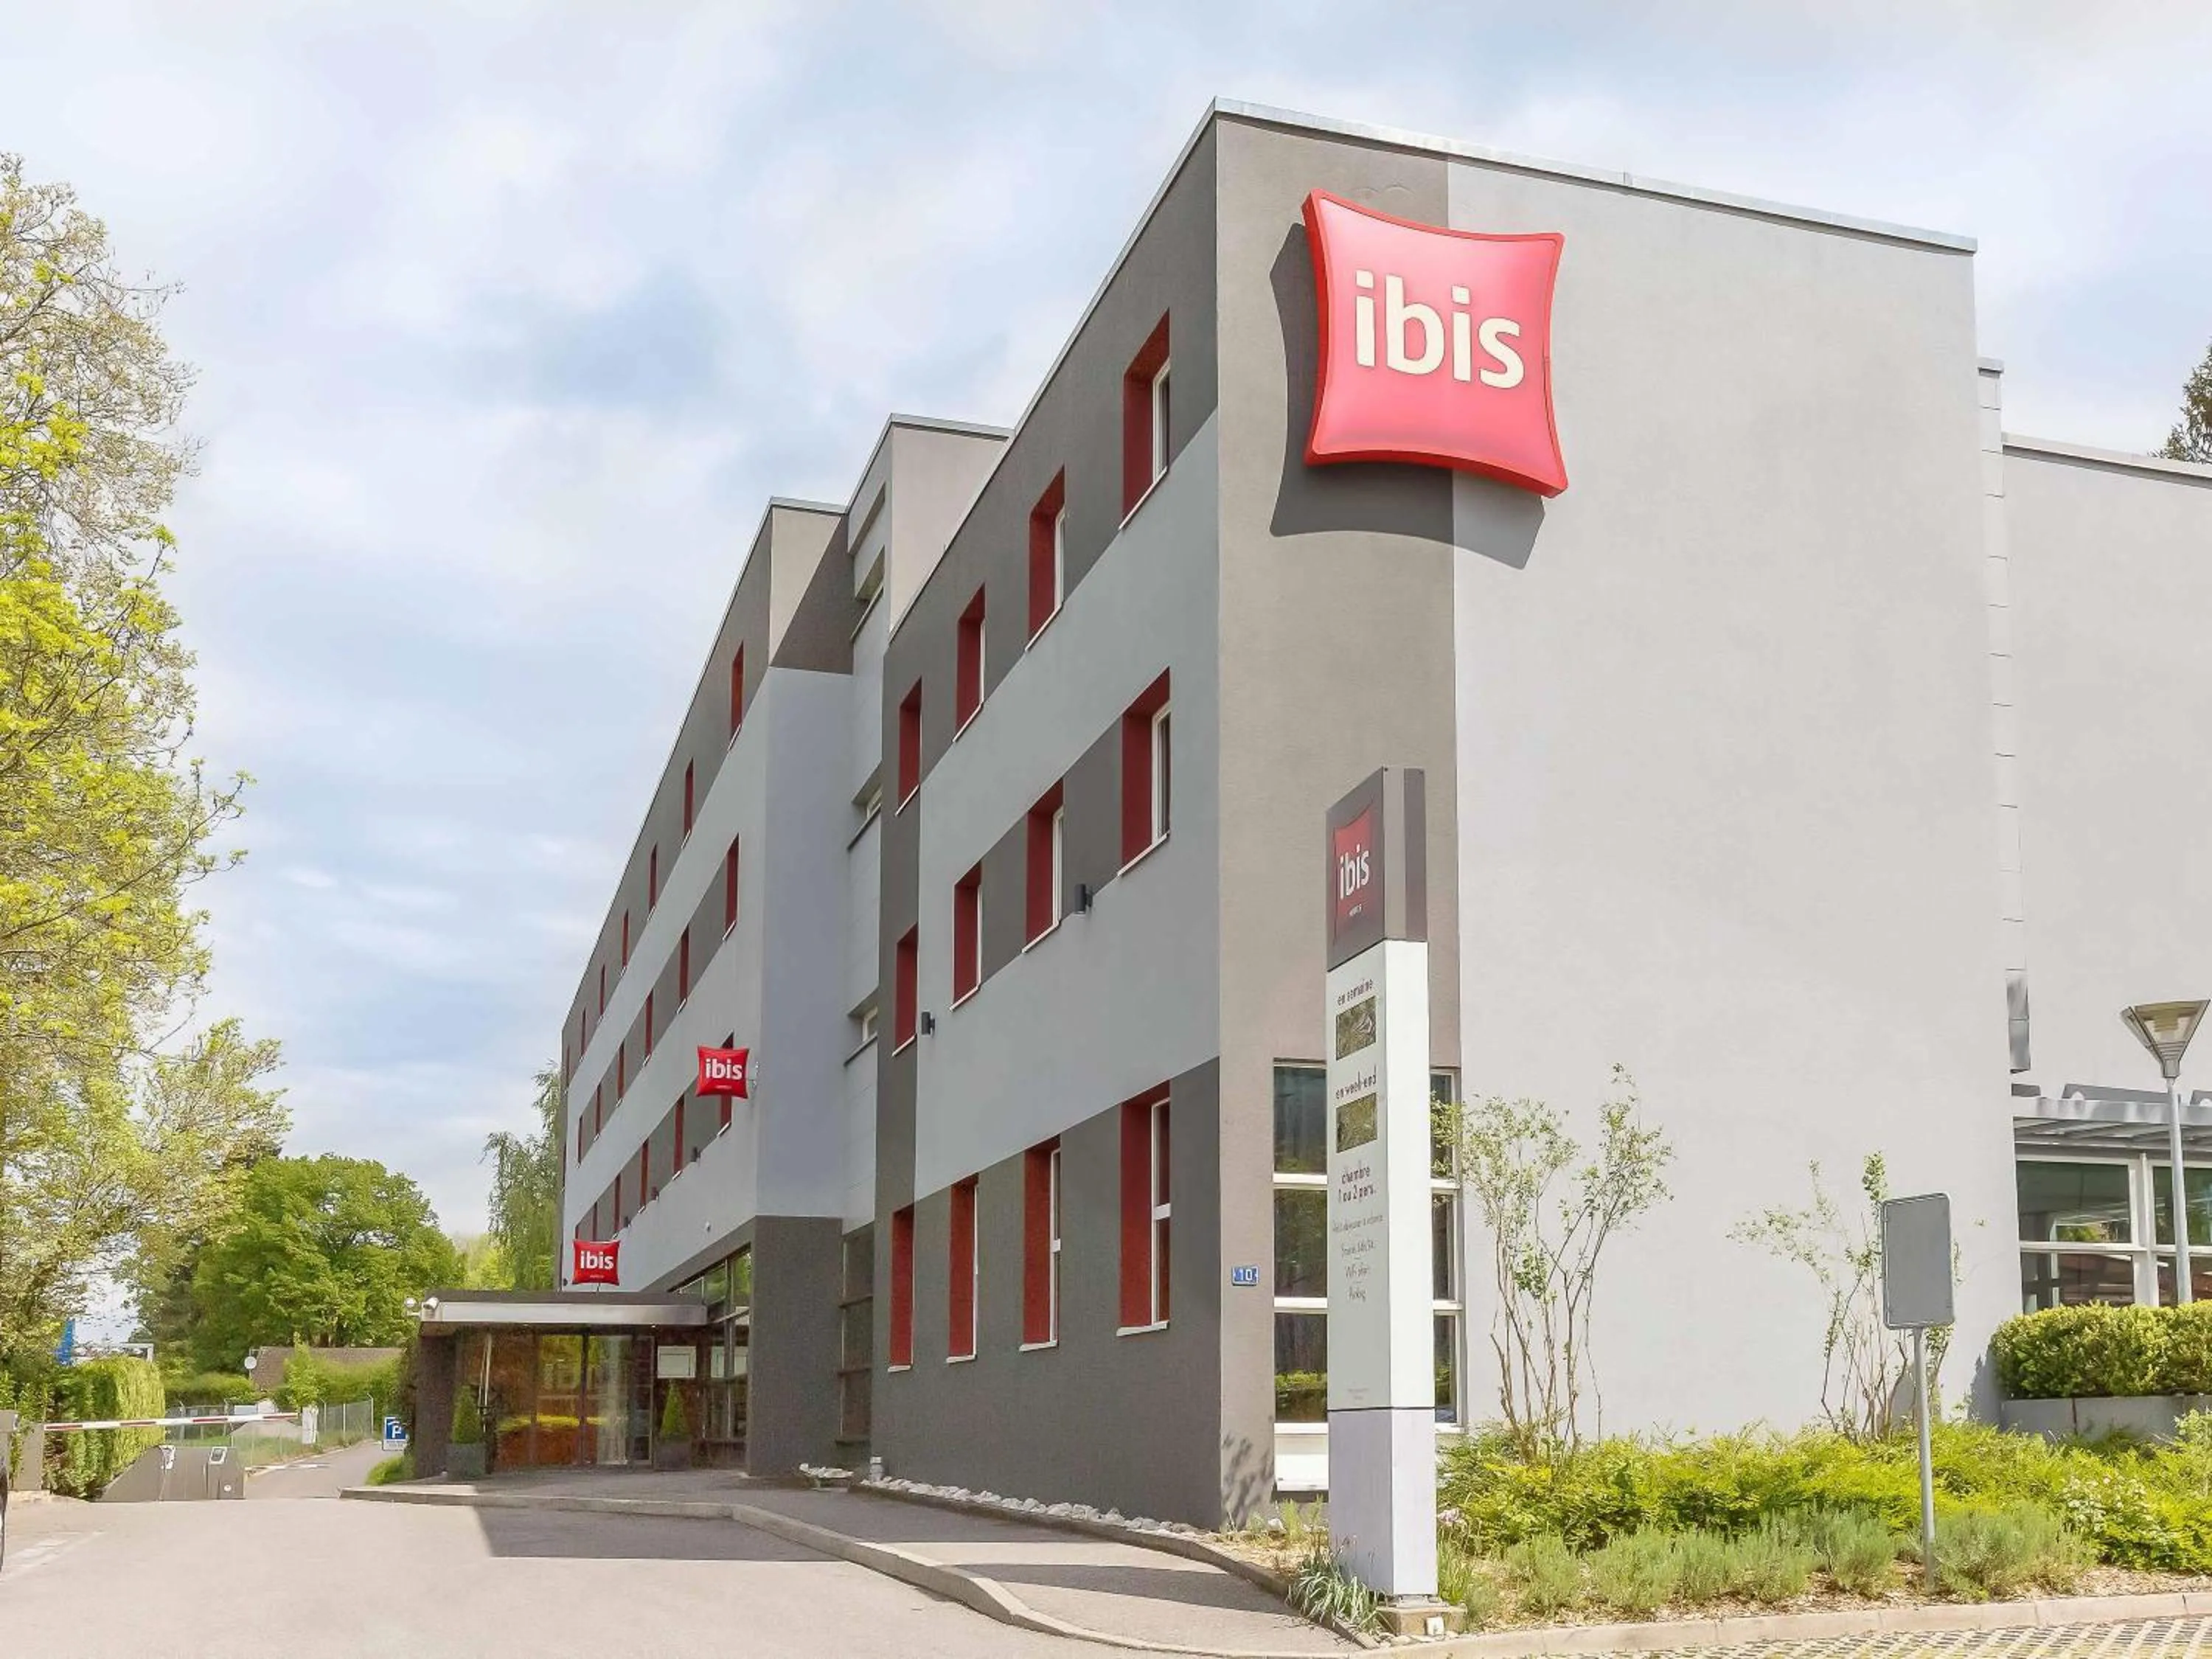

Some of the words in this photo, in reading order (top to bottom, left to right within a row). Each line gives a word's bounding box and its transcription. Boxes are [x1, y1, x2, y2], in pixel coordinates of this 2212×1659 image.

[1354, 268, 1526, 390] ibis
[1340, 843, 1370, 900] ibis
[705, 1057, 743, 1081] ibis
[580, 1250, 614, 1270] ibis
[1239, 1268, 1253, 1281] 10
